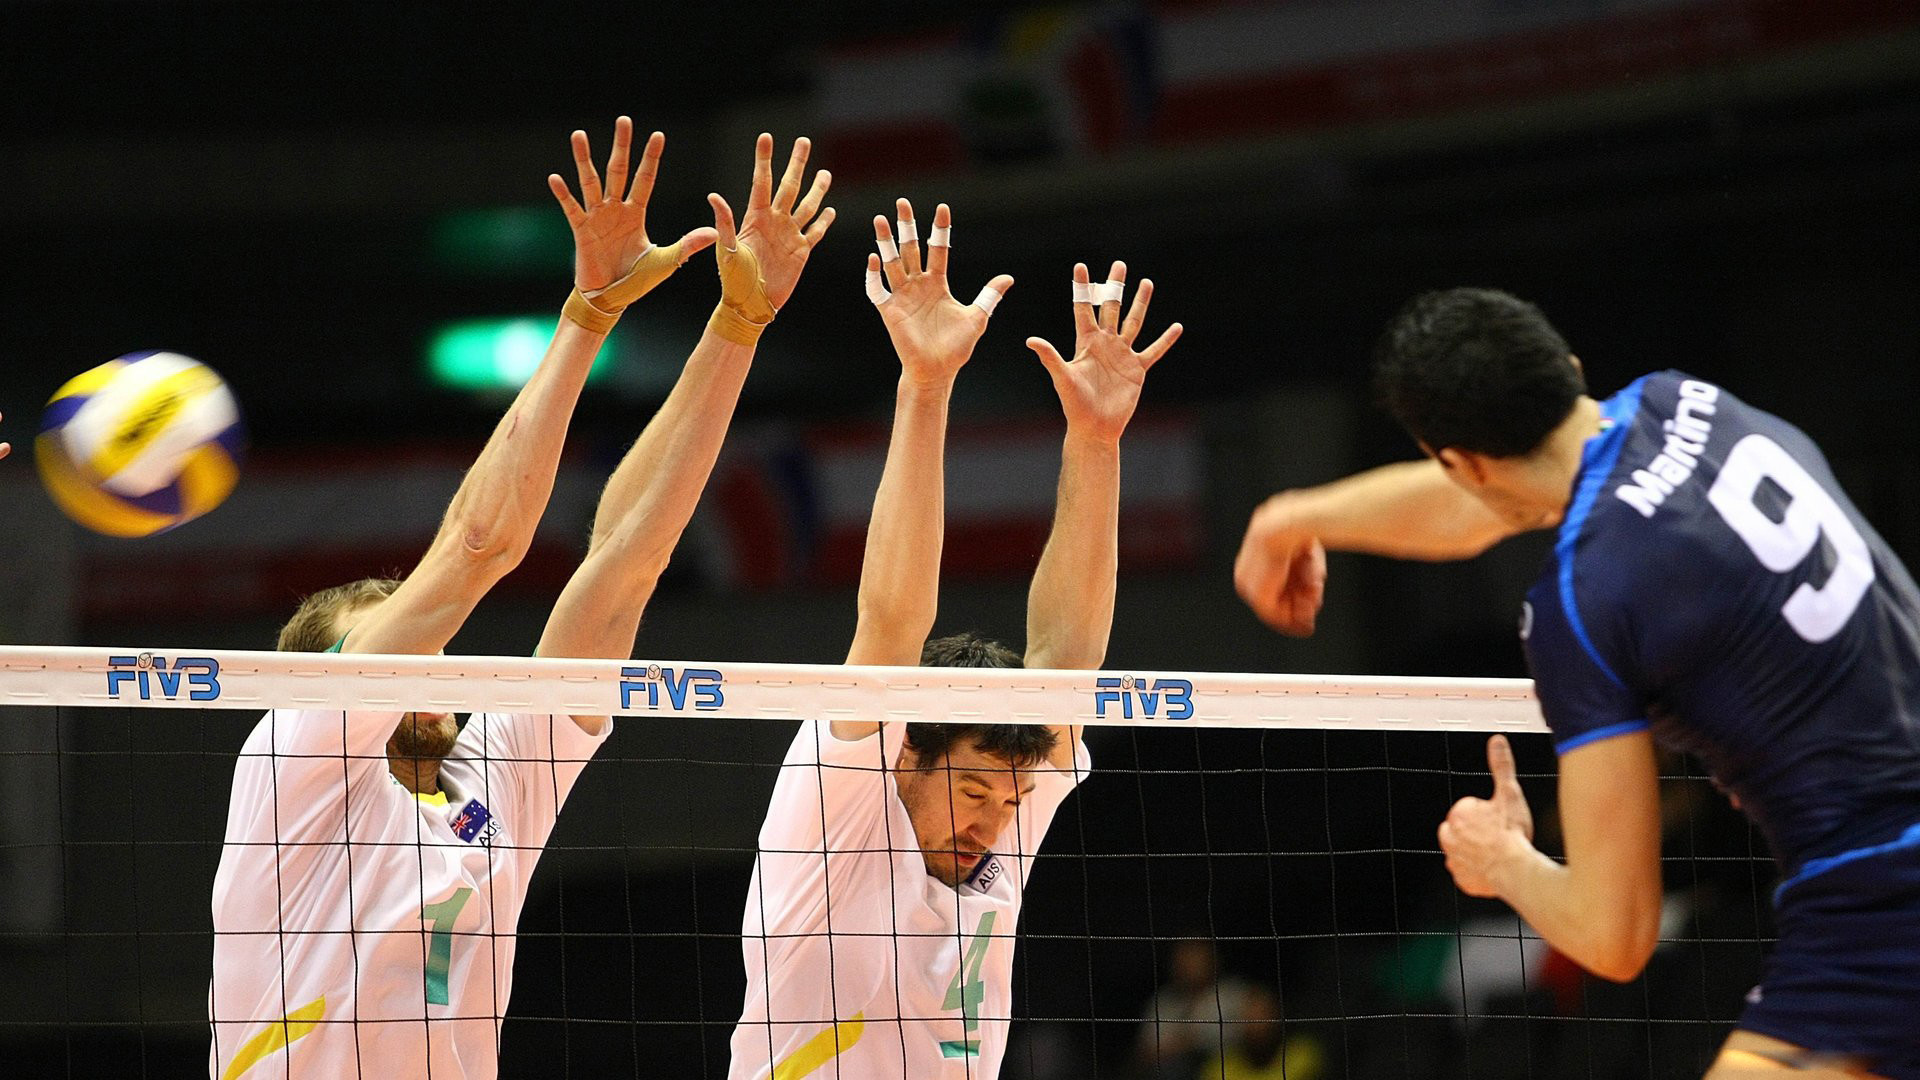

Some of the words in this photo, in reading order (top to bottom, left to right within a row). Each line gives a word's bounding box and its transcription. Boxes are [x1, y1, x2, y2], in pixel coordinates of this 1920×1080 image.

[1614, 379, 1718, 518] Martino
[1707, 433, 1875, 643] 9
[978, 862, 1000, 889] AUS
[418, 887, 473, 1006] 1
[941, 911, 996, 1032] 4
